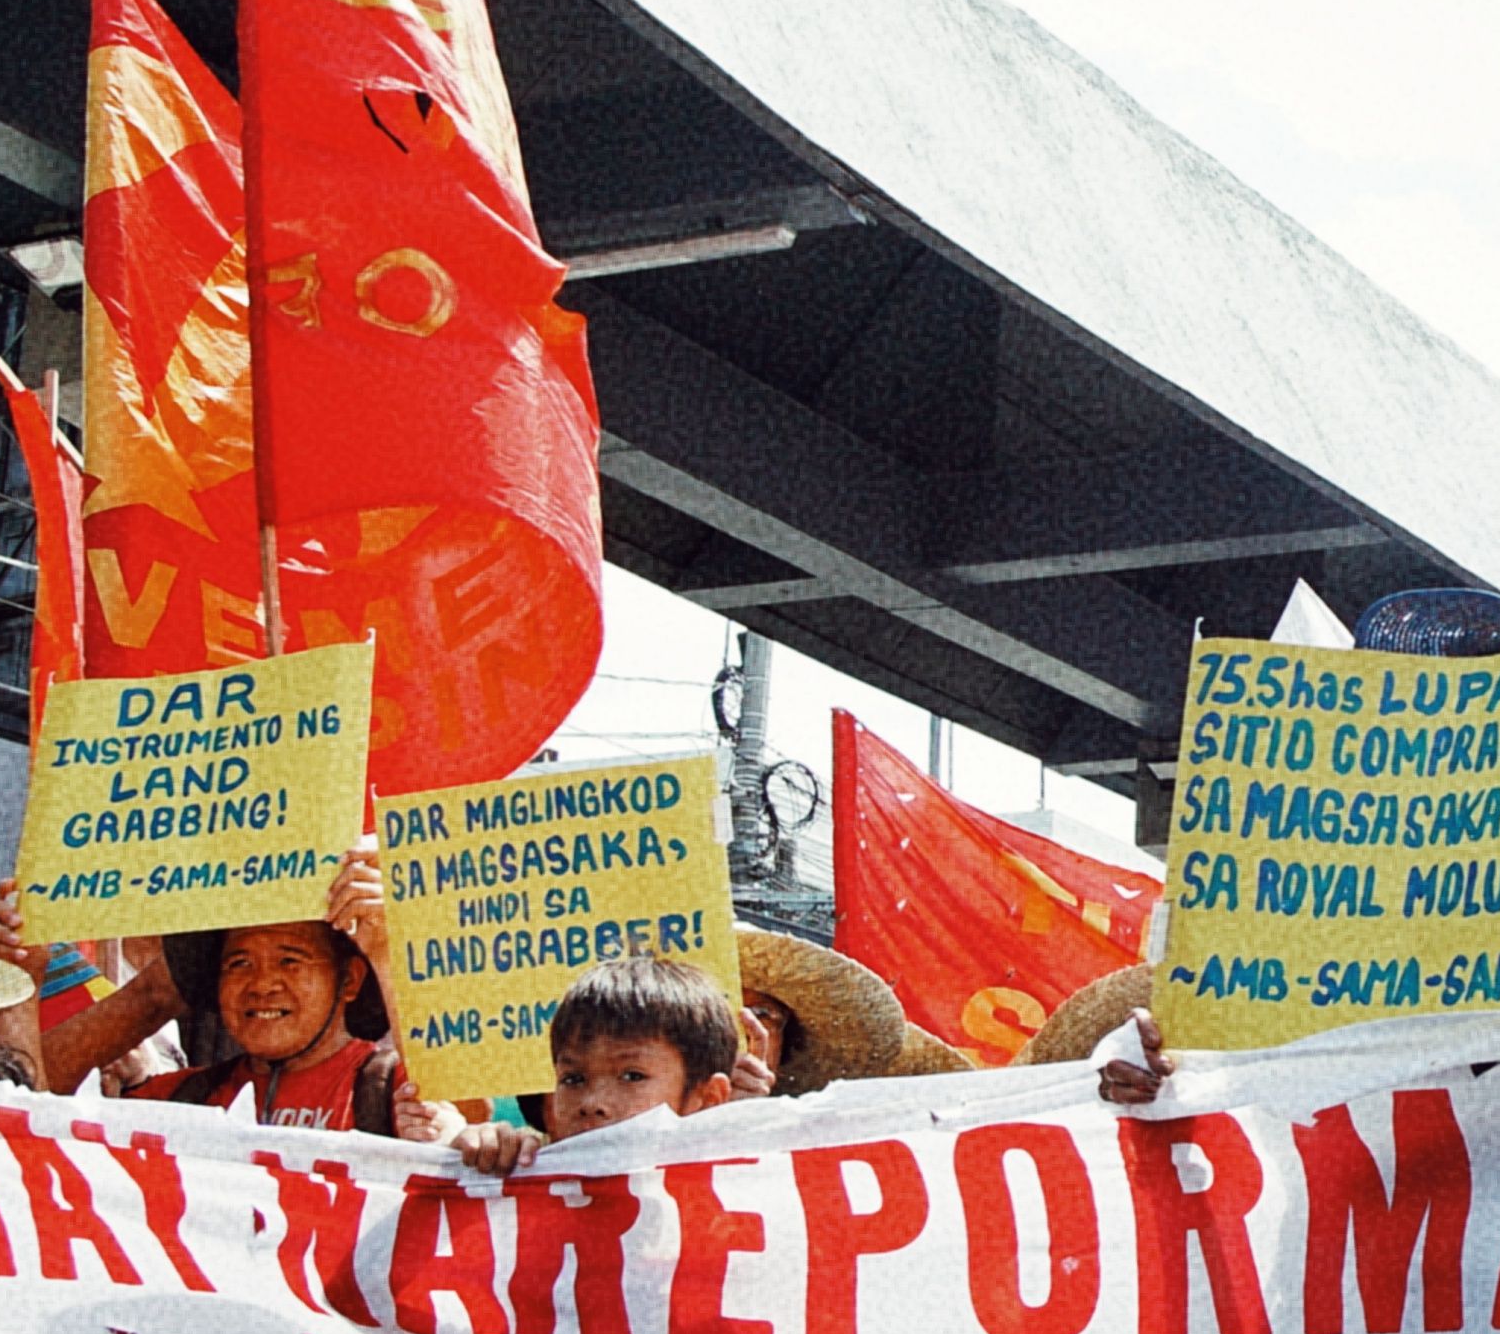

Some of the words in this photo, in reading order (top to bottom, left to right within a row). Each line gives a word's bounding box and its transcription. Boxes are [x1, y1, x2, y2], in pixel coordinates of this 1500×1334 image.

[117, 674, 255, 728] DAR
[52, 717, 282, 766] INSTRUMENTO
[297, 704, 341, 738] NG
[1189, 712, 1313, 768] SITIO
[109, 756, 250, 803] LAND
[1179, 776, 1231, 834] SA
[62, 789, 289, 848] GRABBING!
[386, 803, 449, 848] DAR
[465, 773, 681, 832] MAGLINGKOD
[392, 860, 425, 901] SA
[436, 826, 687, 894] MAGSASAKA,
[1180, 851, 1238, 910] SA
[1256, 858, 1384, 918] ROYAL
[459, 891, 529, 927] HINDI
[544, 886, 590, 918] SA
